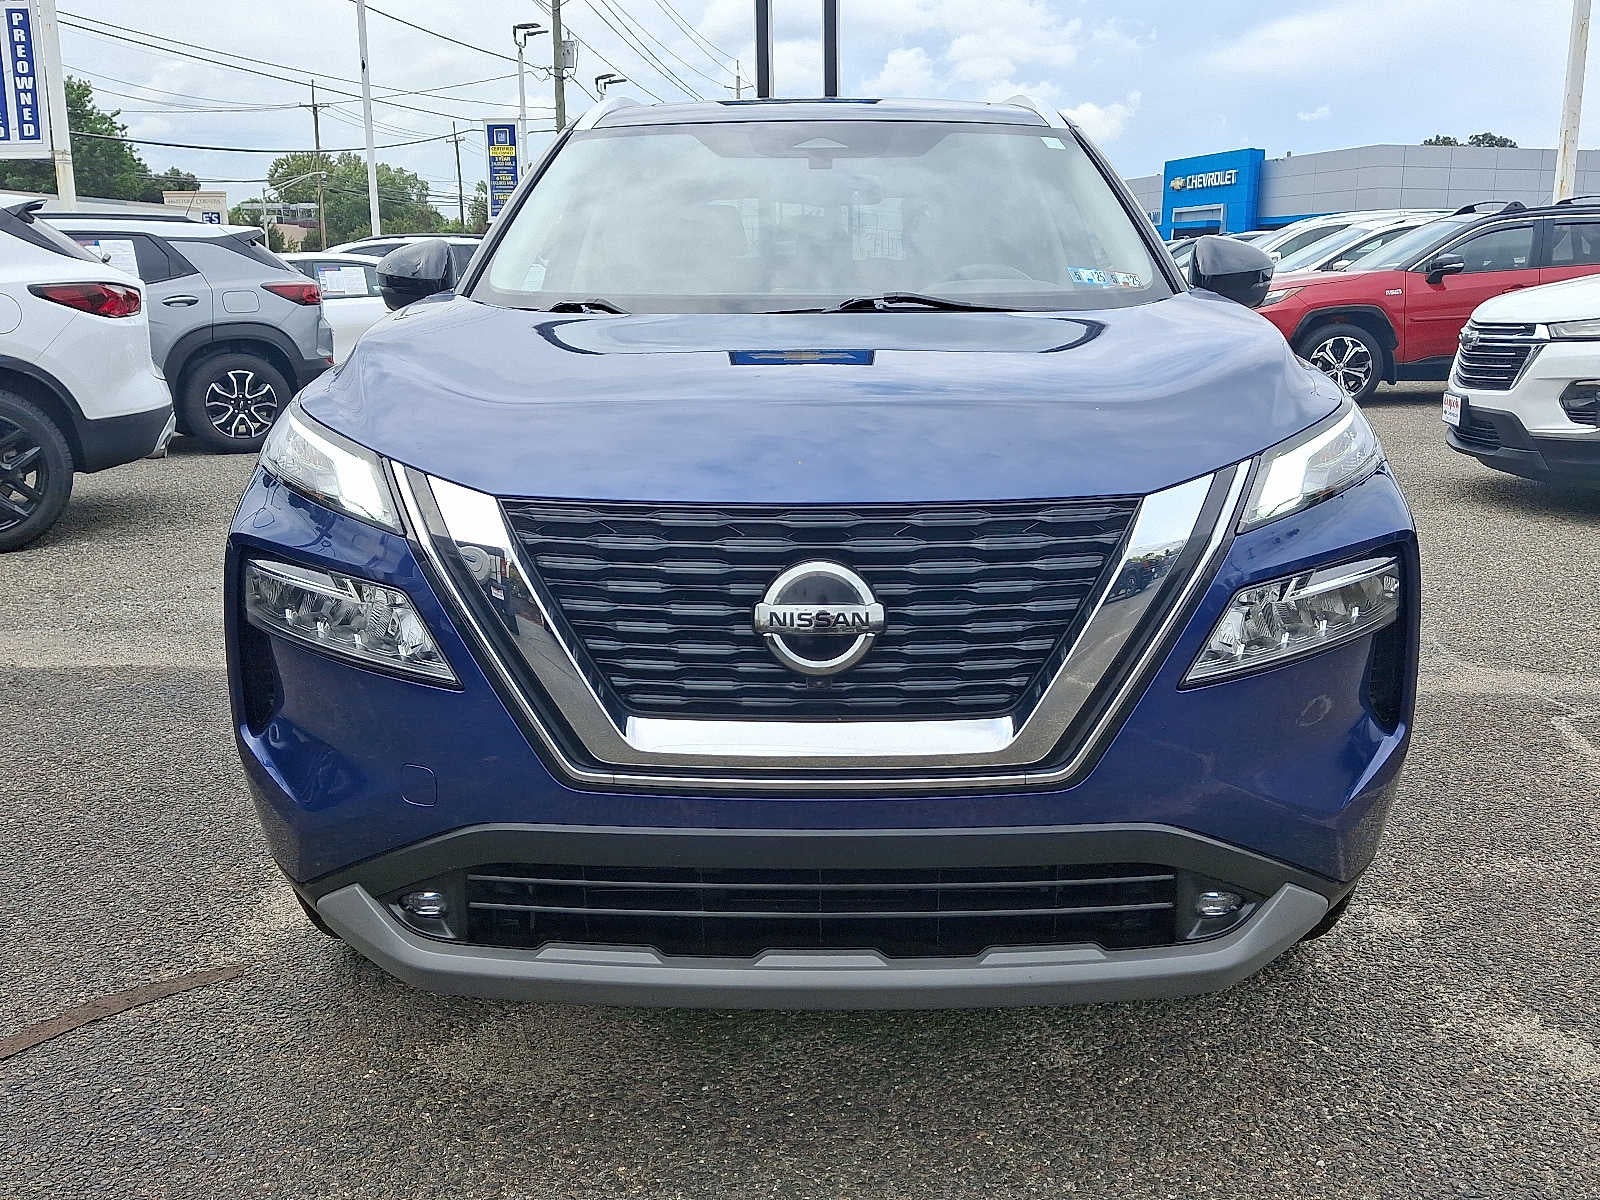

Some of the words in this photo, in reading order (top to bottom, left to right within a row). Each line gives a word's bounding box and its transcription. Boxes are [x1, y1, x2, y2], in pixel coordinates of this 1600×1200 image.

[11, 12, 35, 137] PREOWNED
[1186, 169, 1238, 189] CHEVROLET
[769, 611, 869, 627] NISSAN
